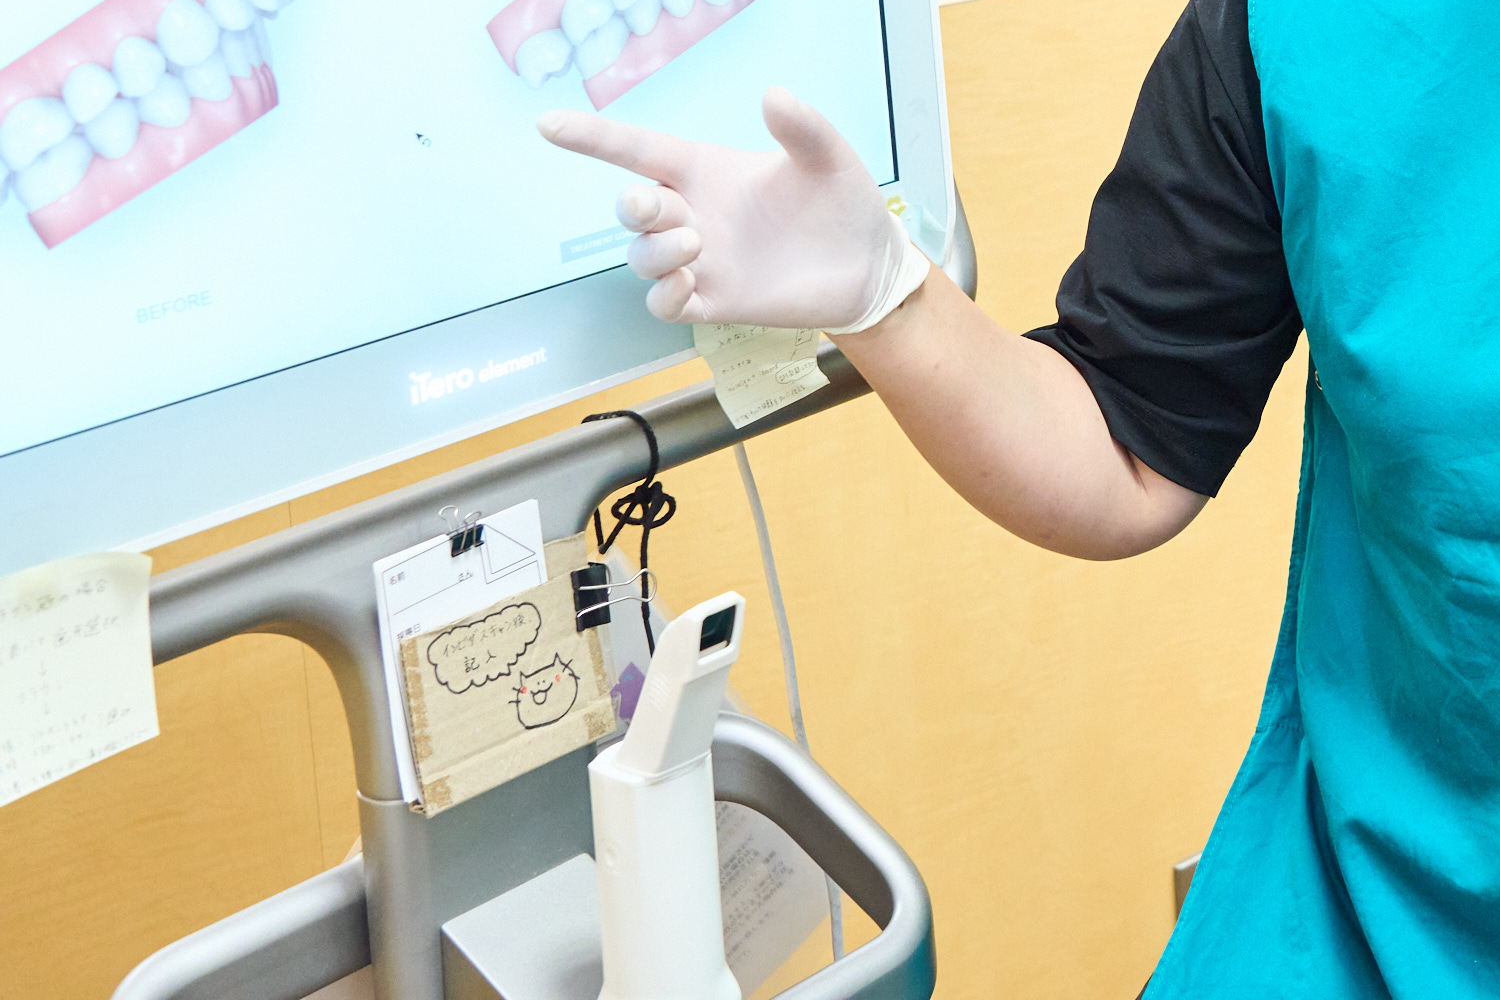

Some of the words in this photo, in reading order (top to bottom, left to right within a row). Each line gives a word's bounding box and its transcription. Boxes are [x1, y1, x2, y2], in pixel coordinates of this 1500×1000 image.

[136, 289, 214, 325] BEFORE
[408, 367, 475, 406] iTero
[477, 346, 548, 383] element
[389, 571, 406, 586] 名前
[457, 569, 473, 582] さん
